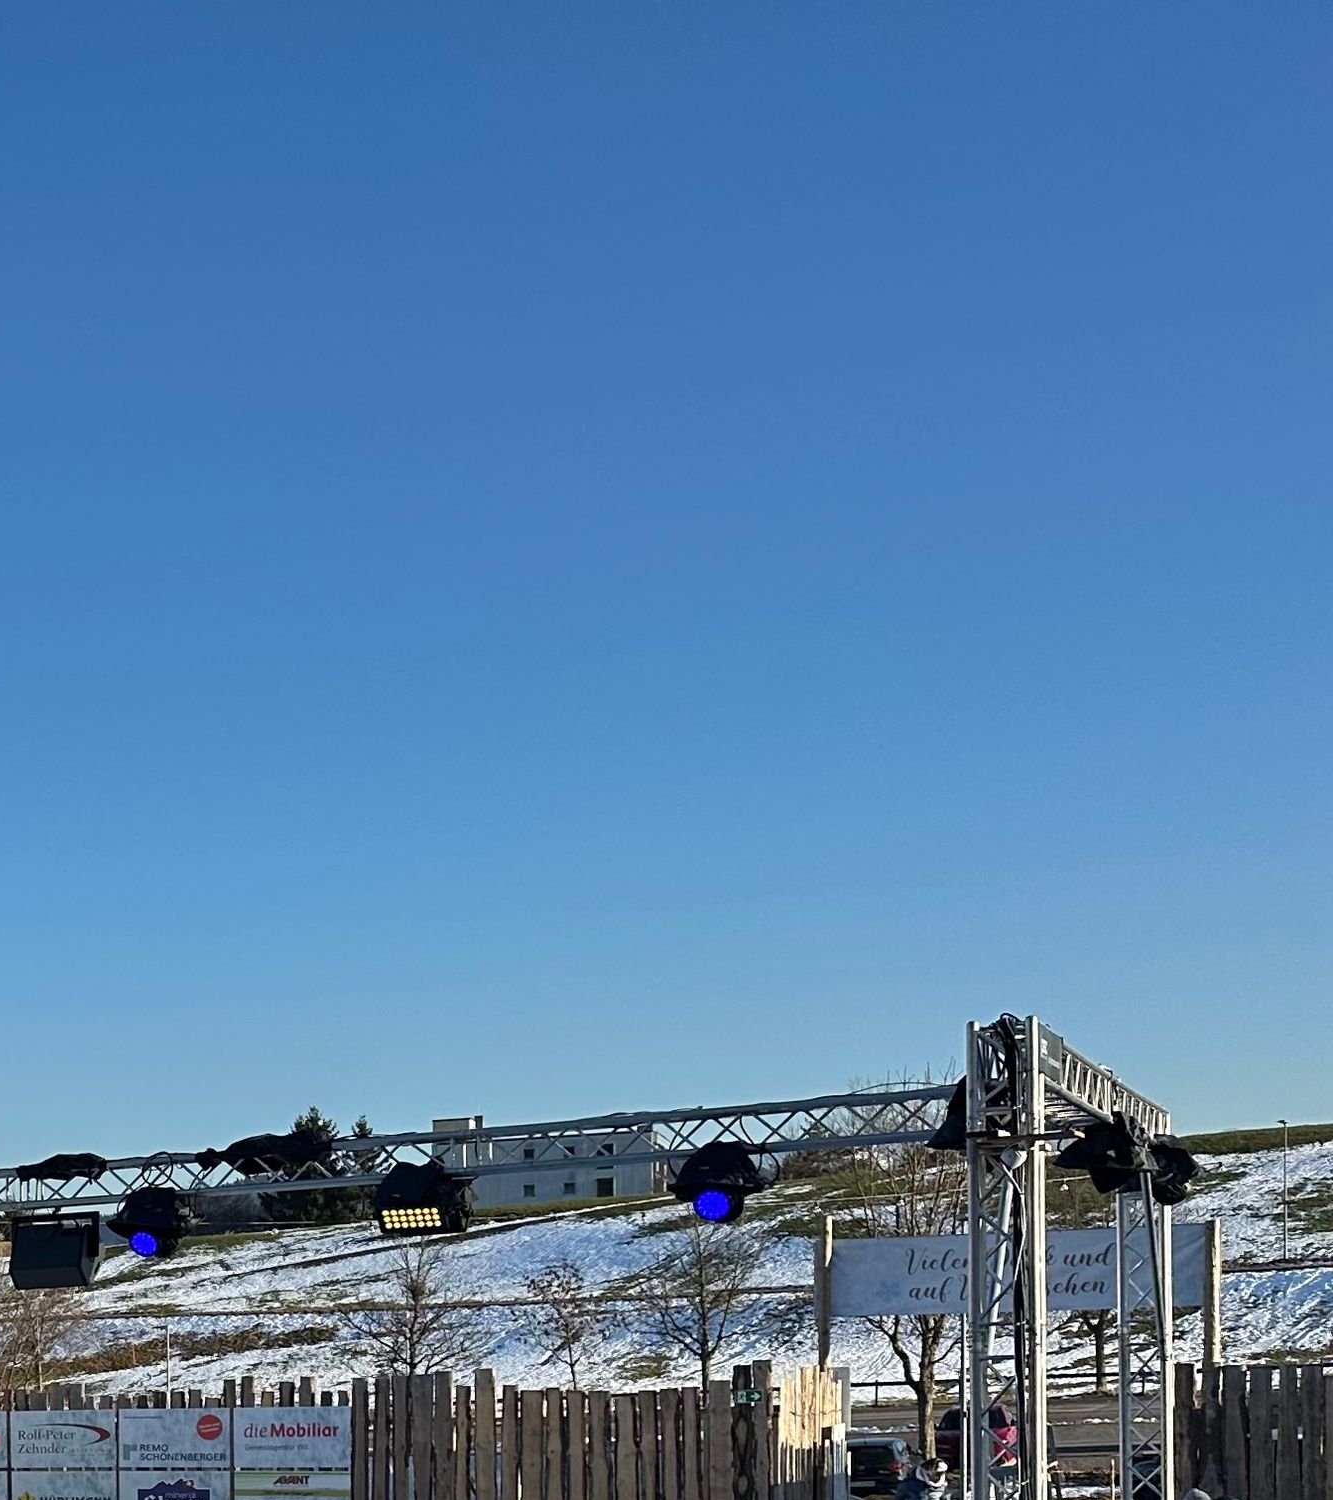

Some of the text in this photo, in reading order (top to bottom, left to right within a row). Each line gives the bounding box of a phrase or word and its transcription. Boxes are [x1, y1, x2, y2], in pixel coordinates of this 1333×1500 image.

[1063, 1242, 1116, 1267] und
[908, 1276, 956, 1303] auf
[17, 1430, 76, 1441] Rolf-Peter
[244, 1423, 339, 1438] die Mobiliar
[17, 1444, 66, 1454] Zehnder
[139, 1444, 168, 1452] REMO
[139, 1452, 226, 1461] SCHÖNENBERGER
